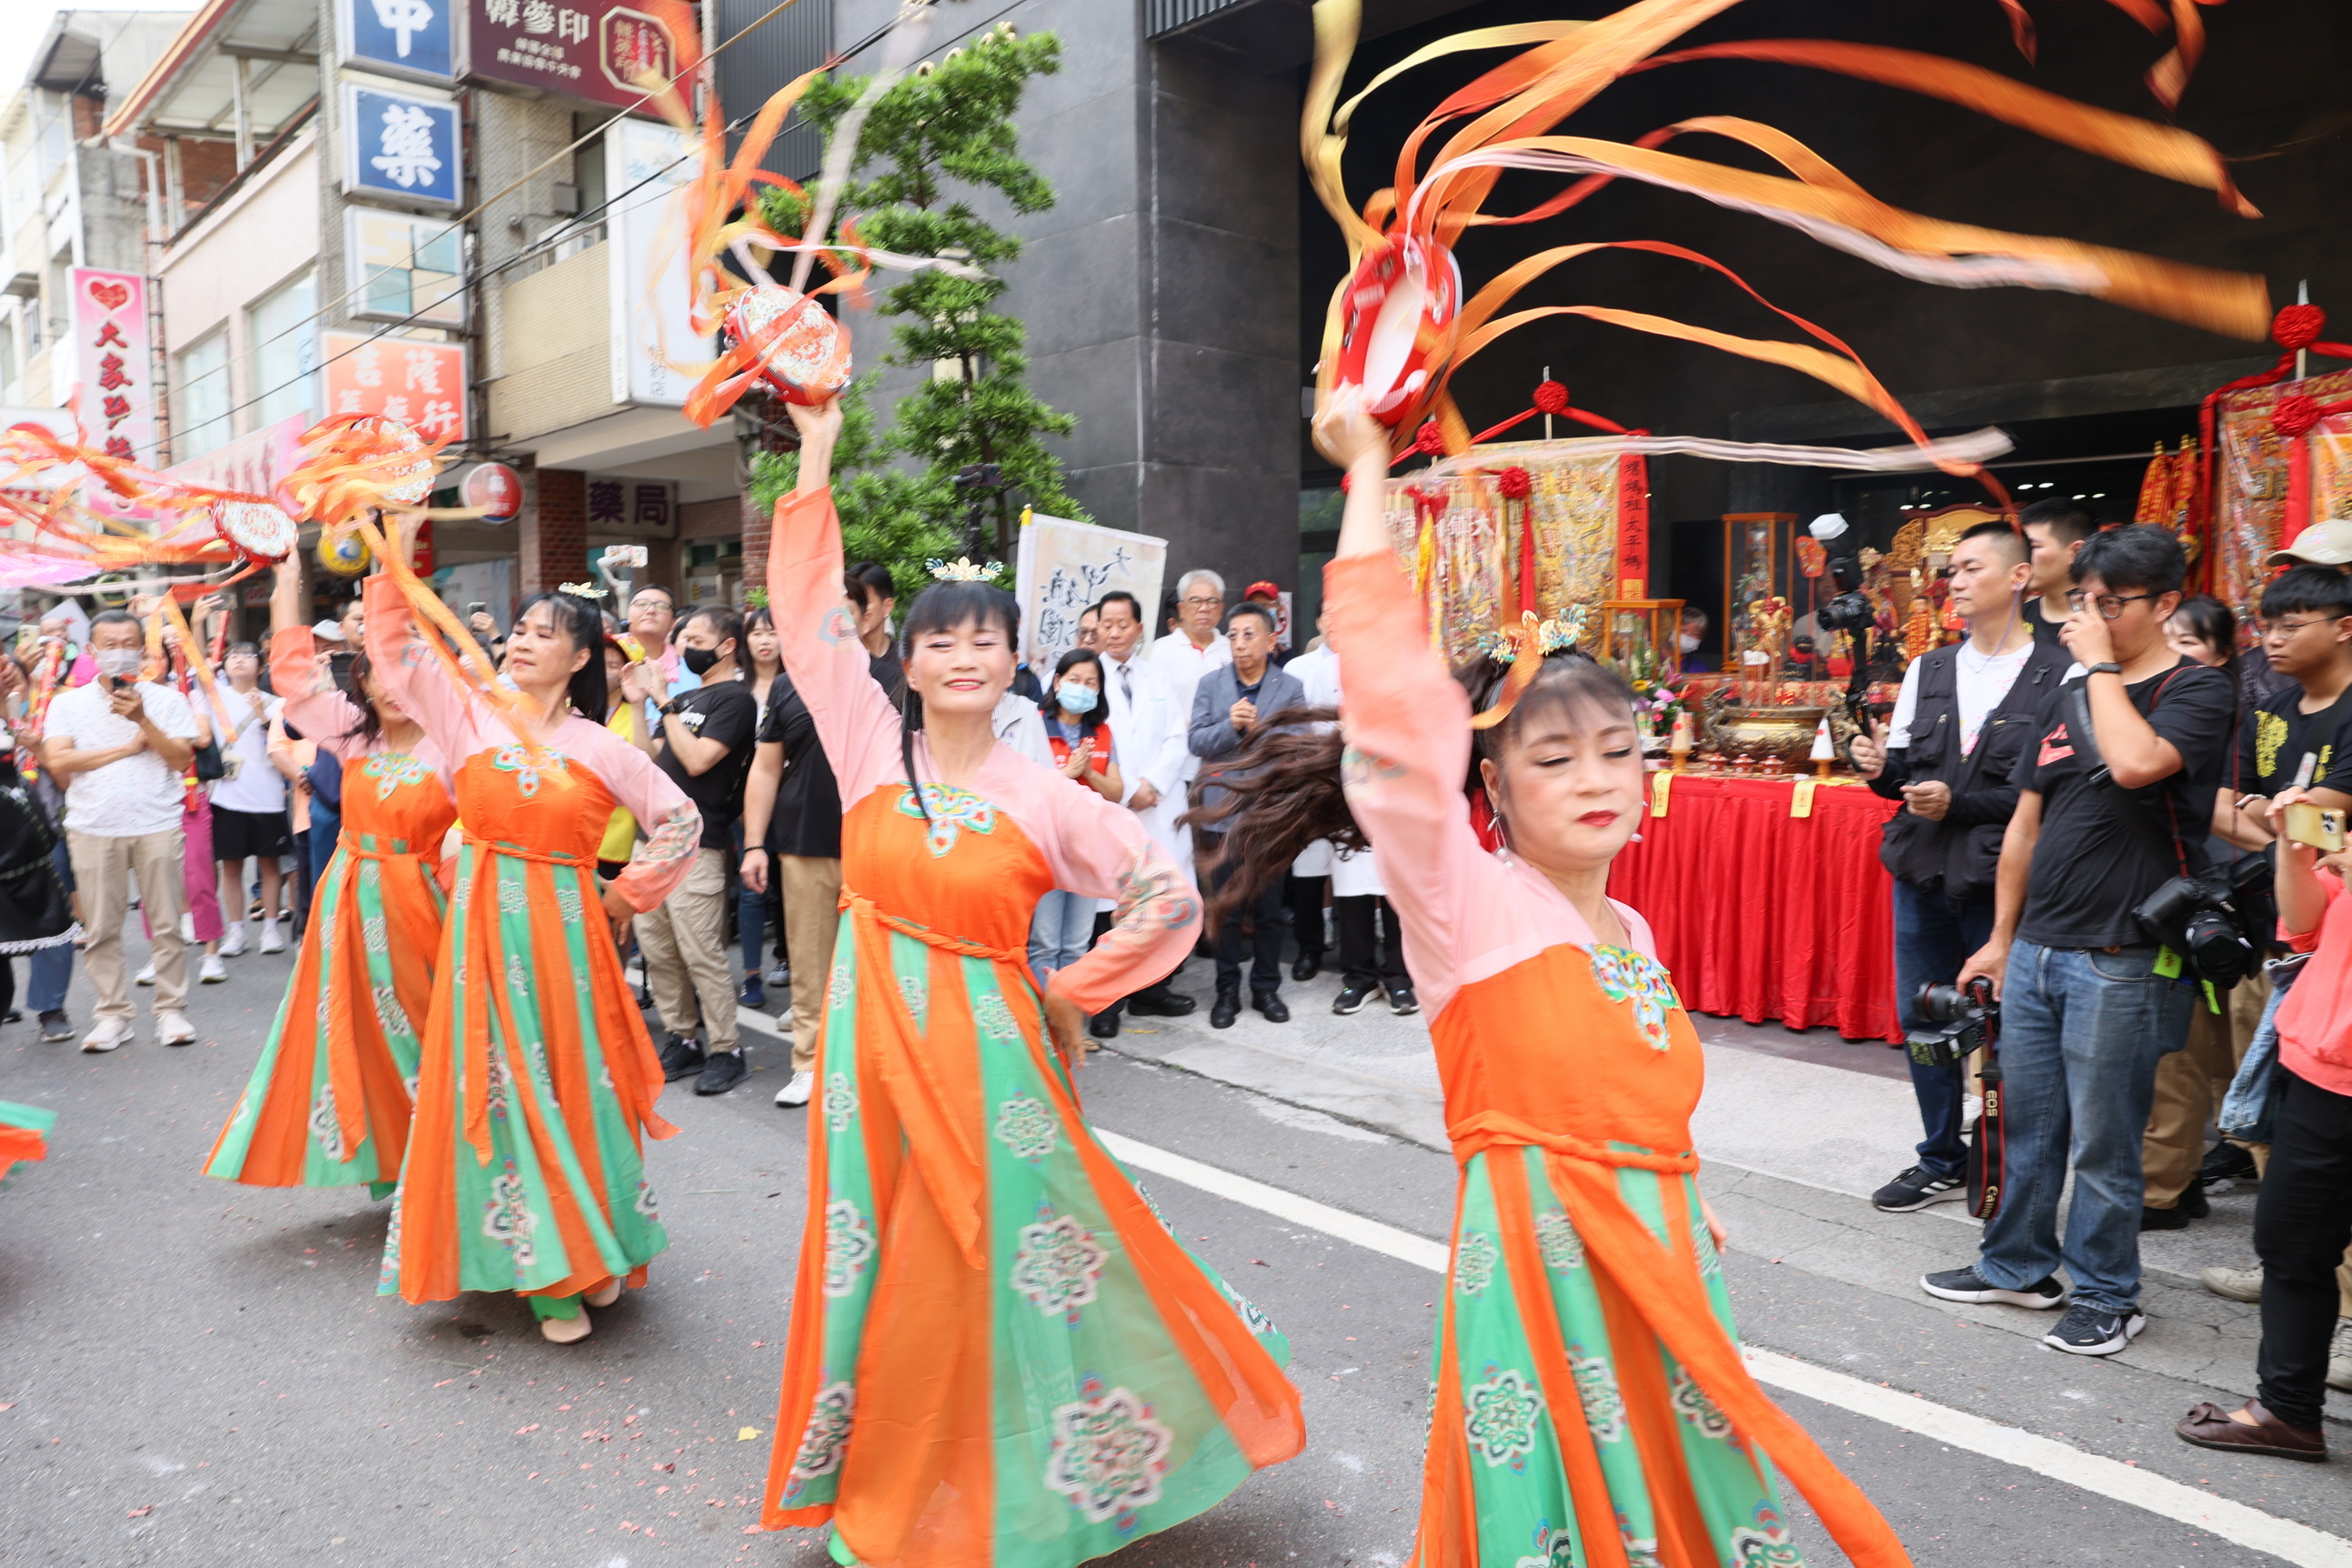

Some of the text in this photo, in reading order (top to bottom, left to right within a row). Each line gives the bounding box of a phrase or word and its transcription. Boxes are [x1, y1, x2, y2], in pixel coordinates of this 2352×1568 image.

[371, 104, 442, 188] 藥
[588, 480, 669, 526] 藥局
[1985, 1090, 1998, 1117] EOS
[1979, 1185, 1999, 1219] Canon
